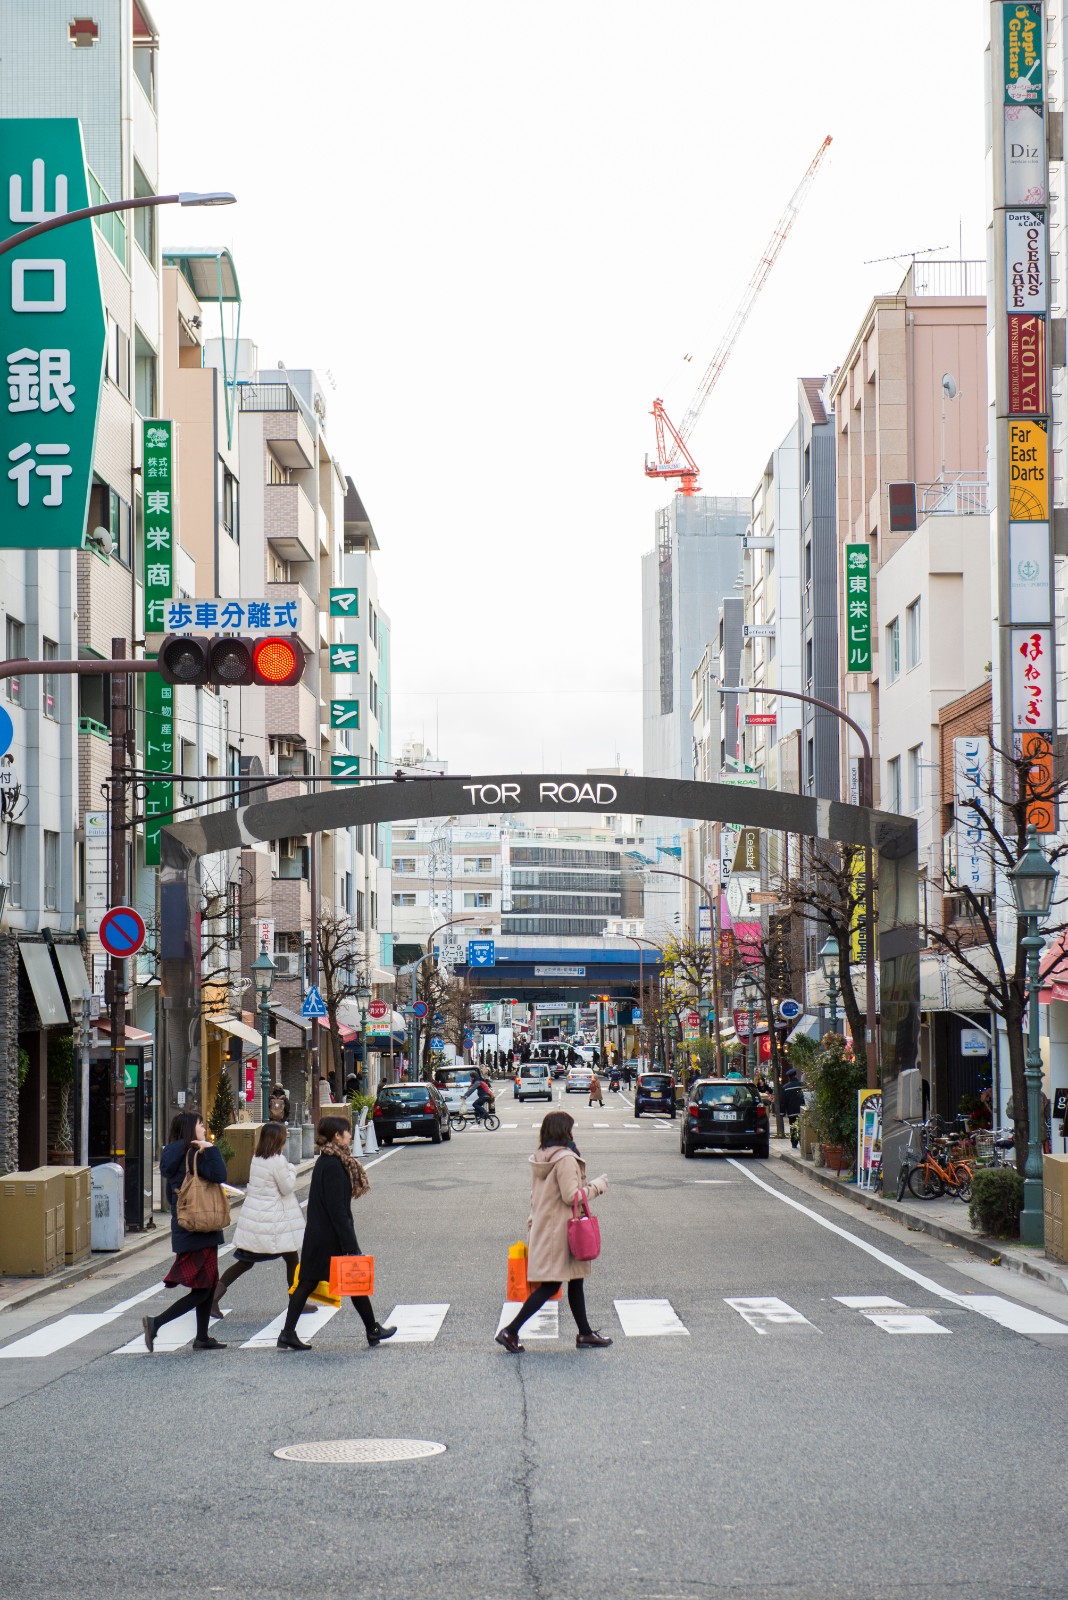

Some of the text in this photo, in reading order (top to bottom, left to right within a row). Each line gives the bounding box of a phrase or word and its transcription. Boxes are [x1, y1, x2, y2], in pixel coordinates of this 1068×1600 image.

[1008, 18, 1021, 79] Guitars
[1021, 18, 1037, 66] Apple
[1010, 143, 1039, 158] Diz
[1012, 262, 1026, 308] CAFE
[8, 157, 76, 507] 山口銀行
[1021, 316, 1037, 411] PATORA
[1011, 365, 1019, 396] MEDICAL
[1012, 399, 1020, 412] THE
[1011, 426, 1032, 443] Far
[147, 456, 168, 467] 株式
[1011, 446, 1037, 462] East
[147, 467, 168, 477] 会社
[1011, 465, 1044, 481] Darts
[146, 489, 170, 623] 東栄商行
[168, 600, 298, 630] 歩車分離式
[848, 575, 868, 664] 東栄ビル
[330, 593, 357, 777] マキシン
[1019, 633, 1043, 725] ほねつぎ
[462, 782, 618, 805] TOR ROAD
[246, 1080, 252, 1089] 2
